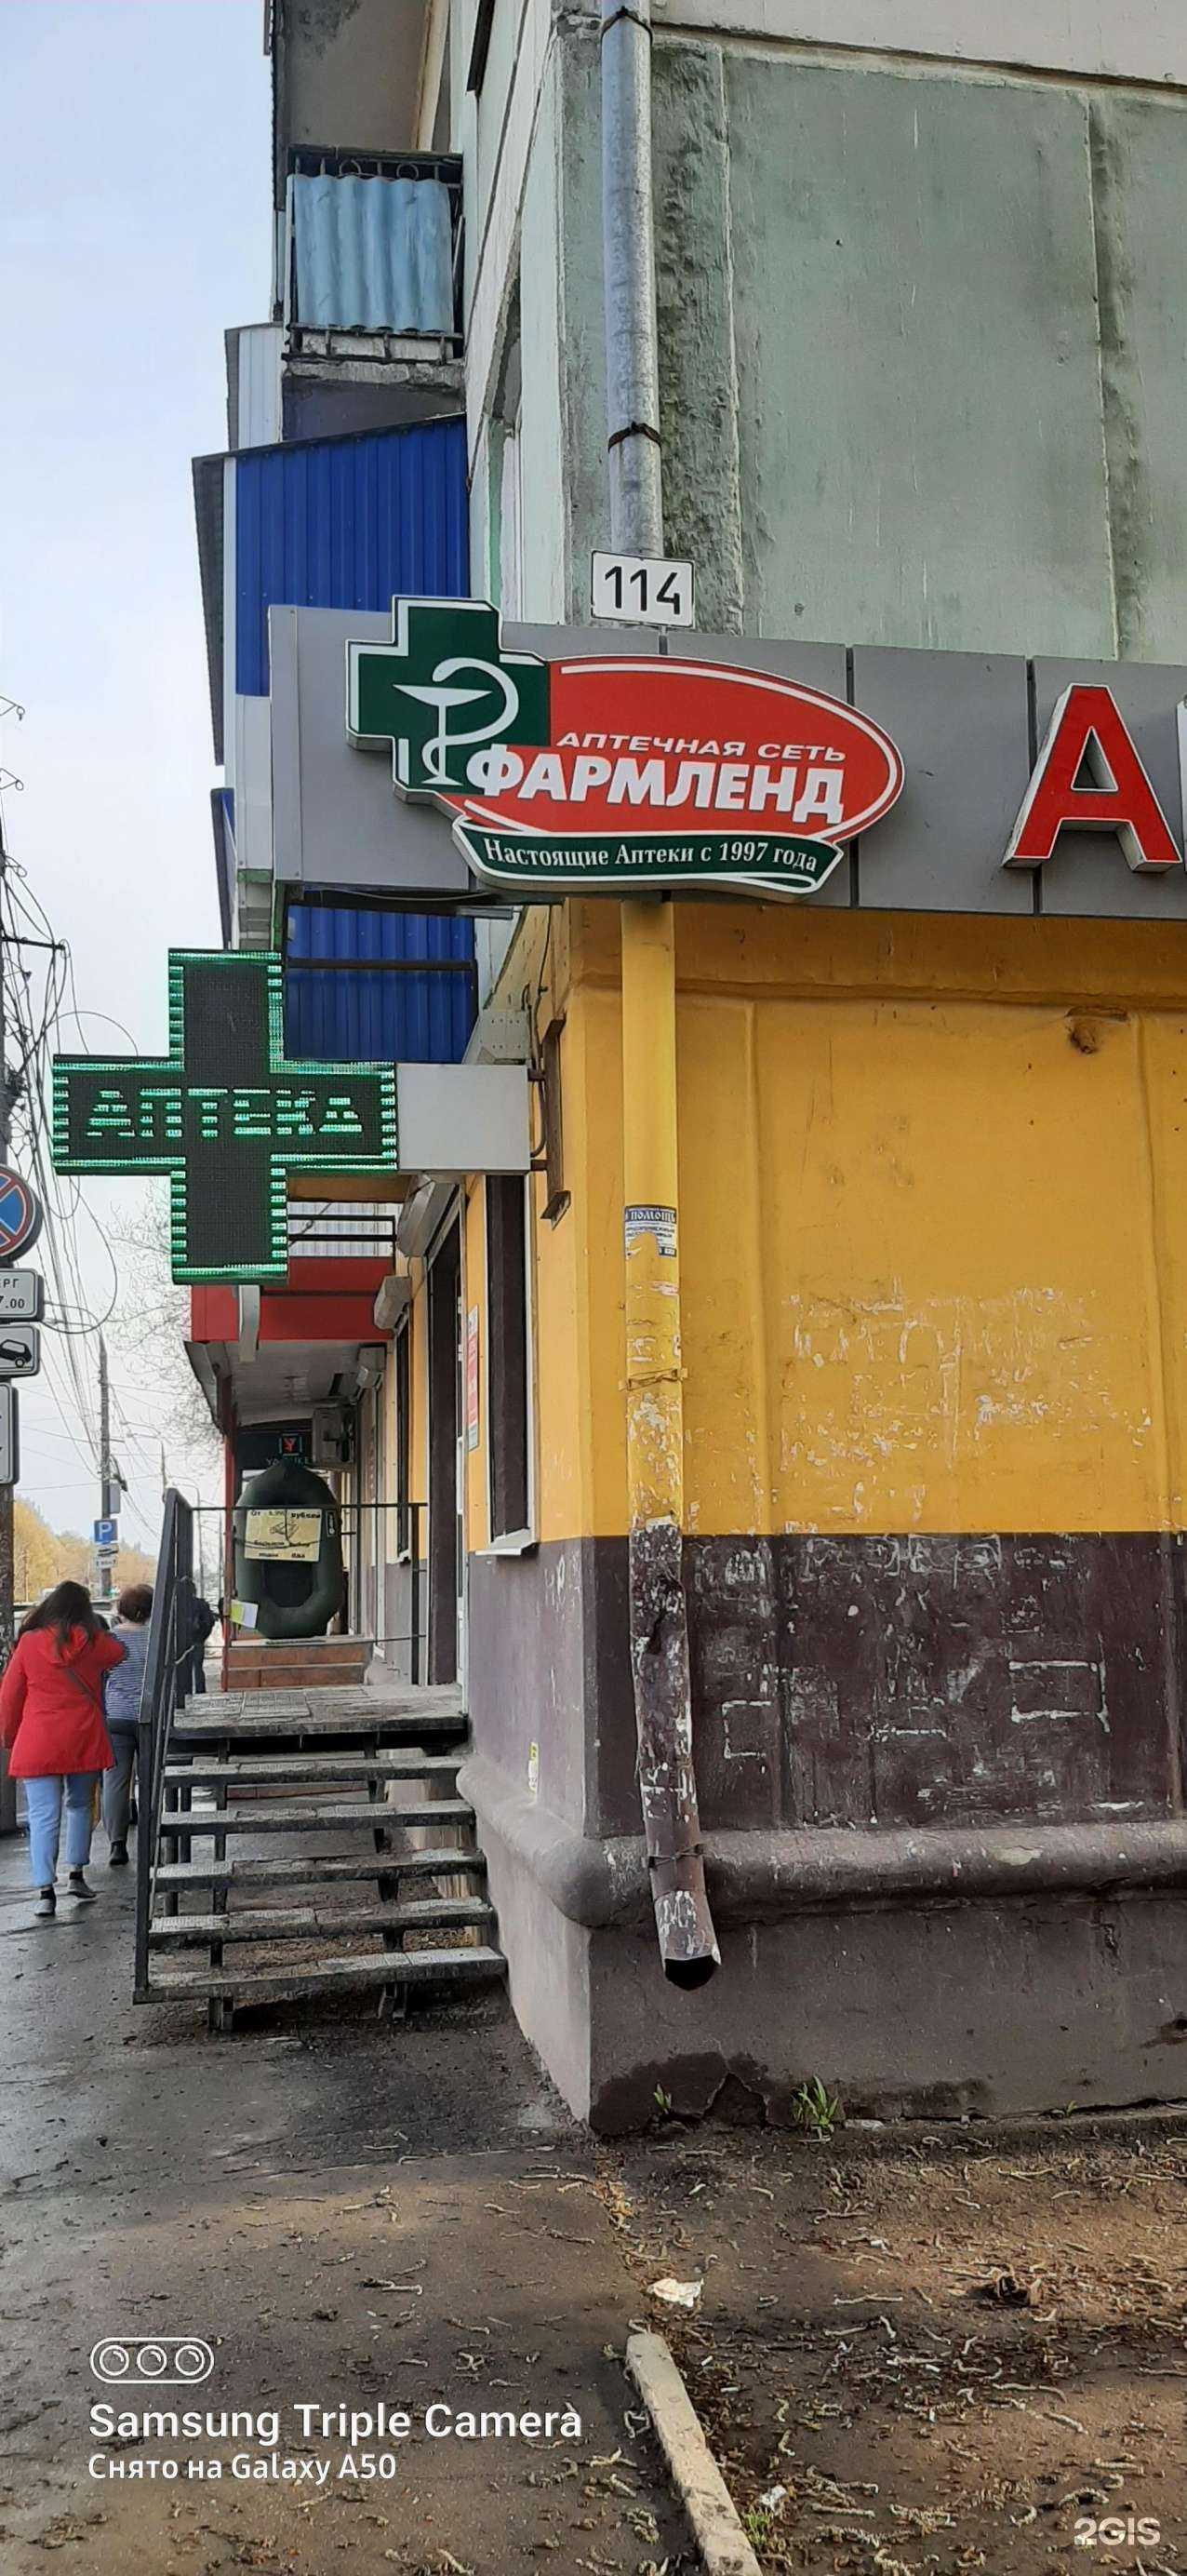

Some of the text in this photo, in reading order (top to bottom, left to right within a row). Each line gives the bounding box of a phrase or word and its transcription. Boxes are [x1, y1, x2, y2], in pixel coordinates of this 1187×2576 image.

[605, 565, 681, 615] 114
[556, 731, 847, 762] АПТЕЧНАЯ СЕТЬ
[466, 744, 845, 825] ФАРМЛЕНД
[1001, 682, 1187, 873] А
[483, 838, 818, 872] Настоящие Аптеки с 1997 года
[87, 1087, 363, 1137] АПТЕКА
[0, 1278, 20, 1289] РГ
